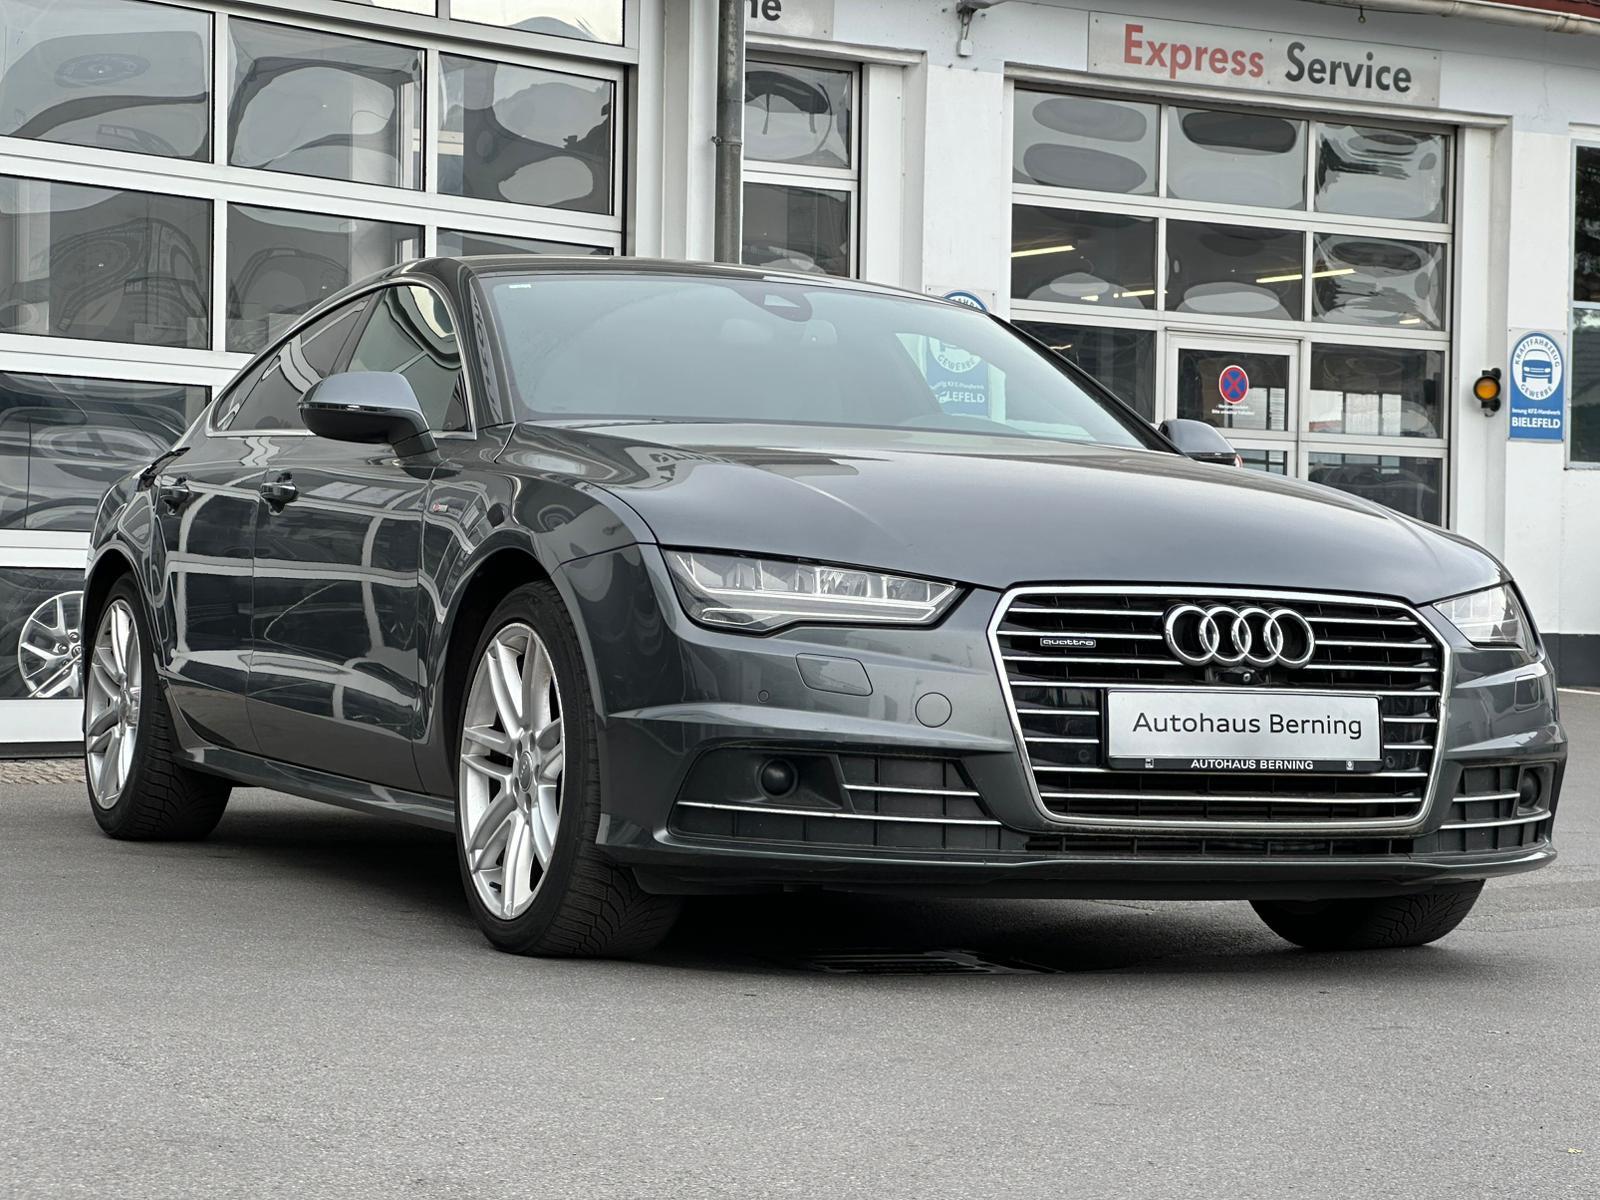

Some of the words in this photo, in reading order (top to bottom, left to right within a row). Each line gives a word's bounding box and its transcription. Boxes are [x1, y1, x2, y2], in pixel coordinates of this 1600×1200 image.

[1123, 23, 1265, 80] Express
[1285, 41, 1412, 93] Service
[1515, 338, 1560, 368] KRAFTFAHRZEUG
[1520, 383, 1553, 398] GEWERBE
[1511, 416, 1561, 429] BIELEFELD
[1132, 712, 1261, 734] Autohaus
[1270, 713, 1362, 740] Berning
[1190, 759, 1257, 769] AUTOHAUS
[1260, 759, 1314, 770] BERNING
